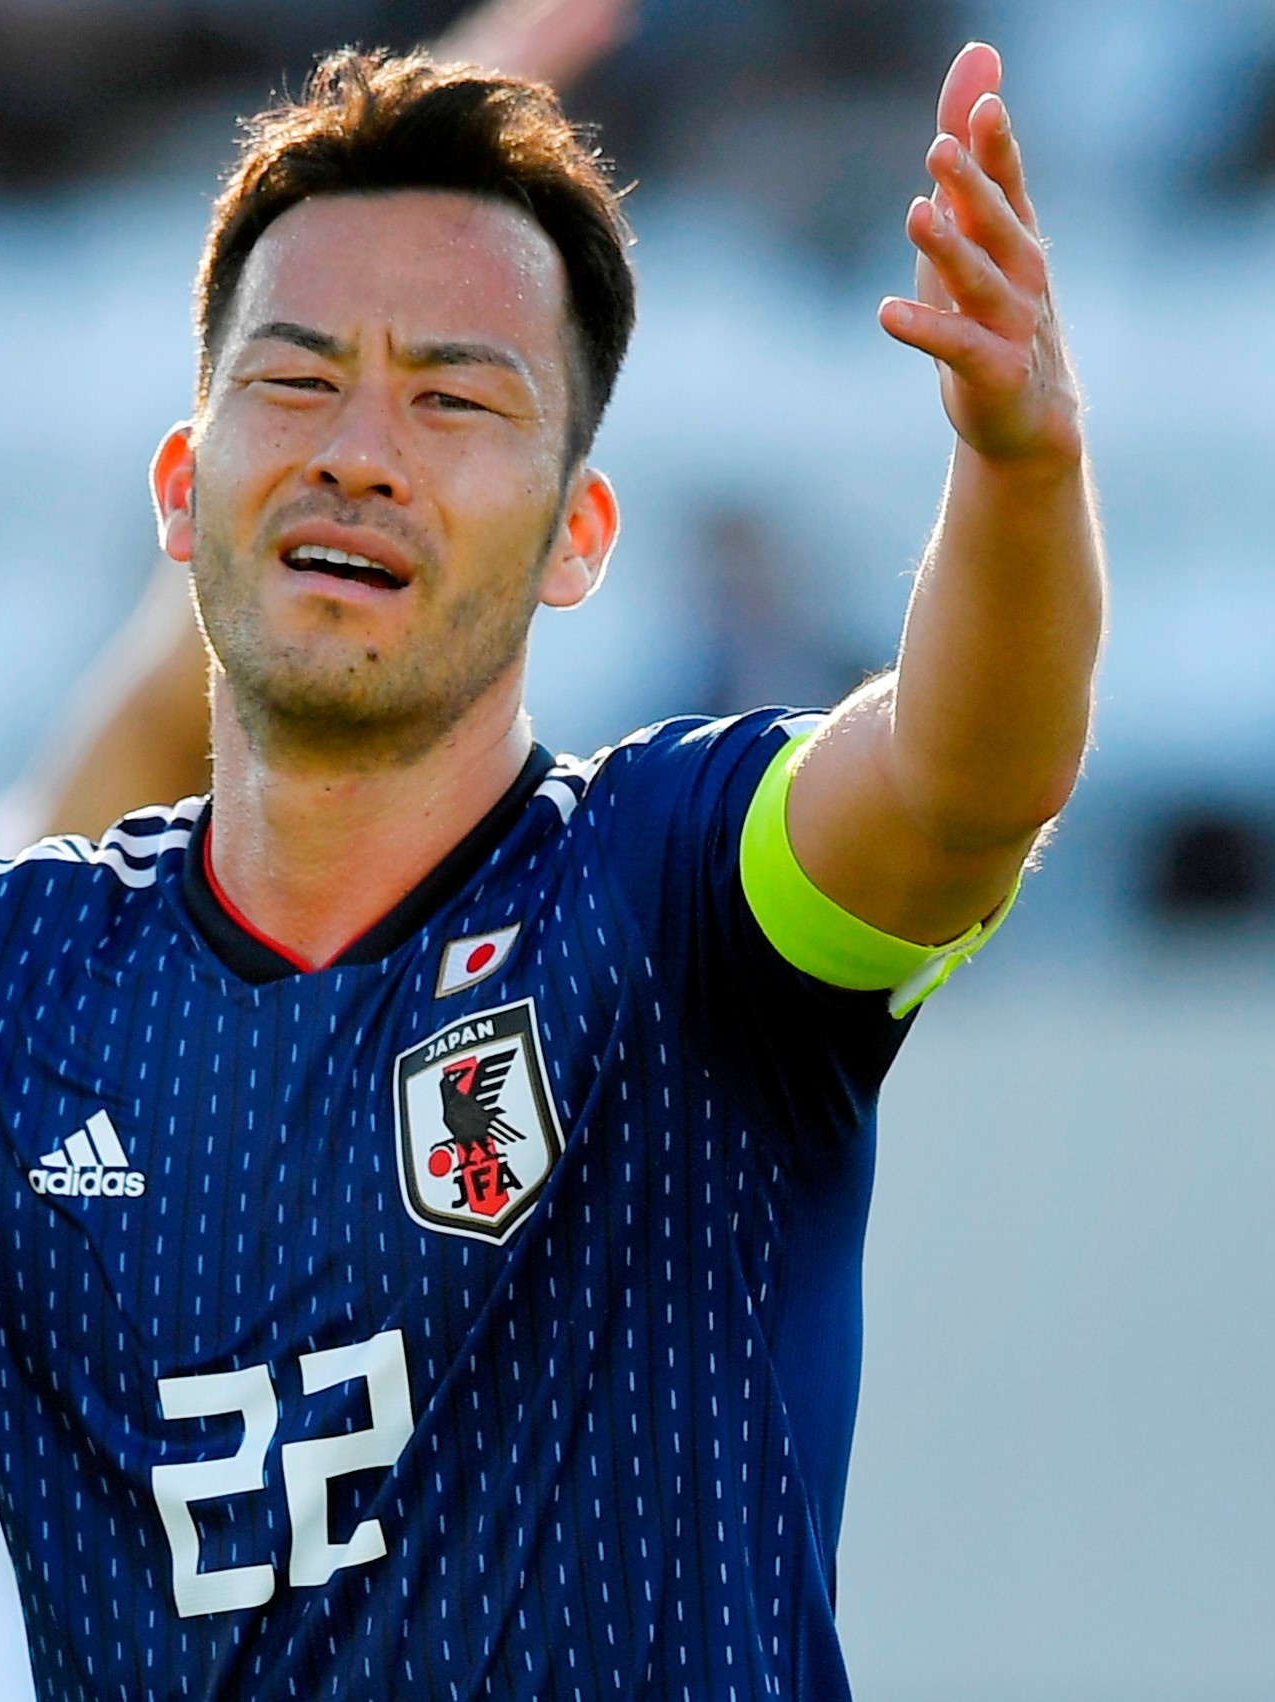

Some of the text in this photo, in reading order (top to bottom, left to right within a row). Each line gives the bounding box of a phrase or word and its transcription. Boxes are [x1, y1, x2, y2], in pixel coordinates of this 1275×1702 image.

[424, 1019, 495, 1062] JAPAN
[28, 1164, 145, 1197] adidas
[451, 1161, 523, 1209] JFA
[152, 1329, 414, 1618] 22
